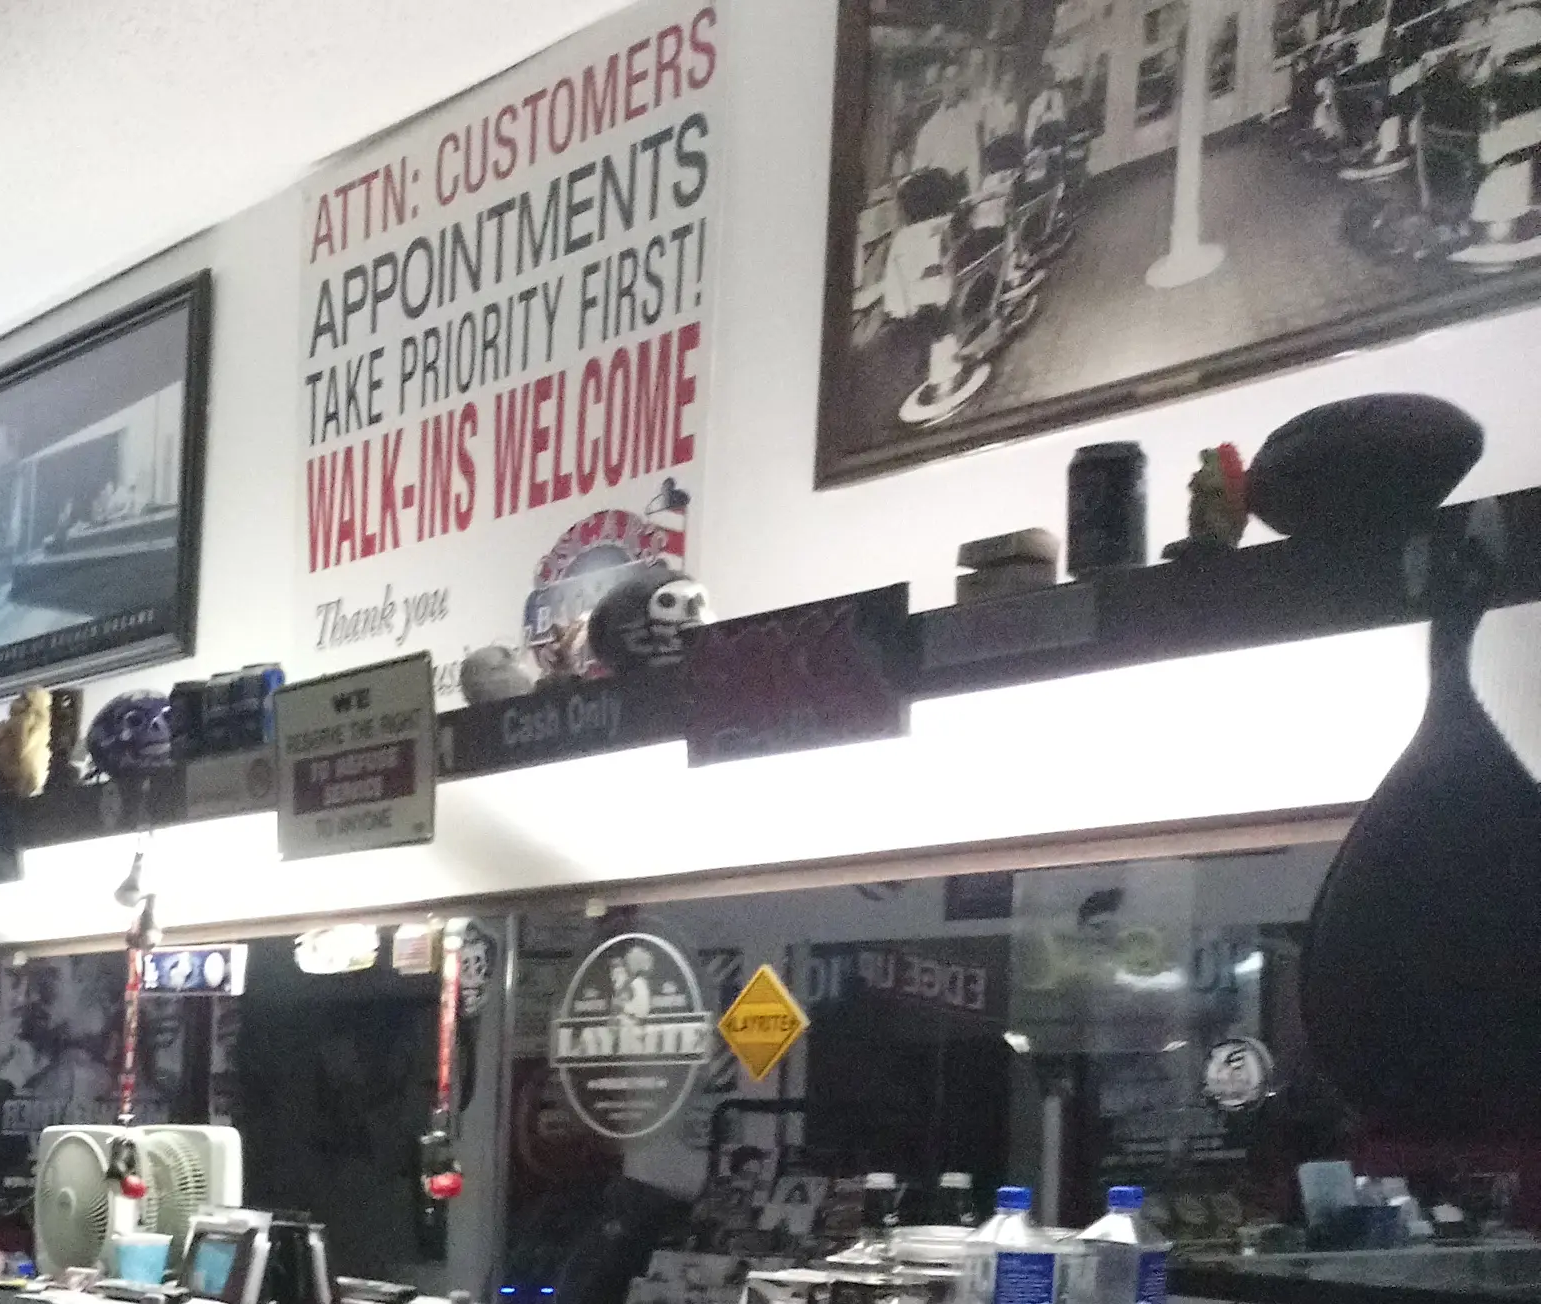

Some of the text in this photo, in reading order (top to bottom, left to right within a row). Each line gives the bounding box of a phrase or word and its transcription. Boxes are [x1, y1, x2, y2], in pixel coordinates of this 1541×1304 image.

[310, 6, 717, 265] ATTN: CUSTOMERS
[309, 112, 710, 358] APPOINTMENTS
[305, 217, 707, 447] TAKE PRIORITY FIRST!
[306, 321, 702, 573] WALK-INS WELCOME
[315, 583, 450, 652] Thank you
[331, 686, 371, 714] WE
[349, 717, 374, 742] THE
[502, 704, 561, 747] Cash
[567, 688, 623, 743] Only
[558, 1019, 710, 1058] LAYRITE
